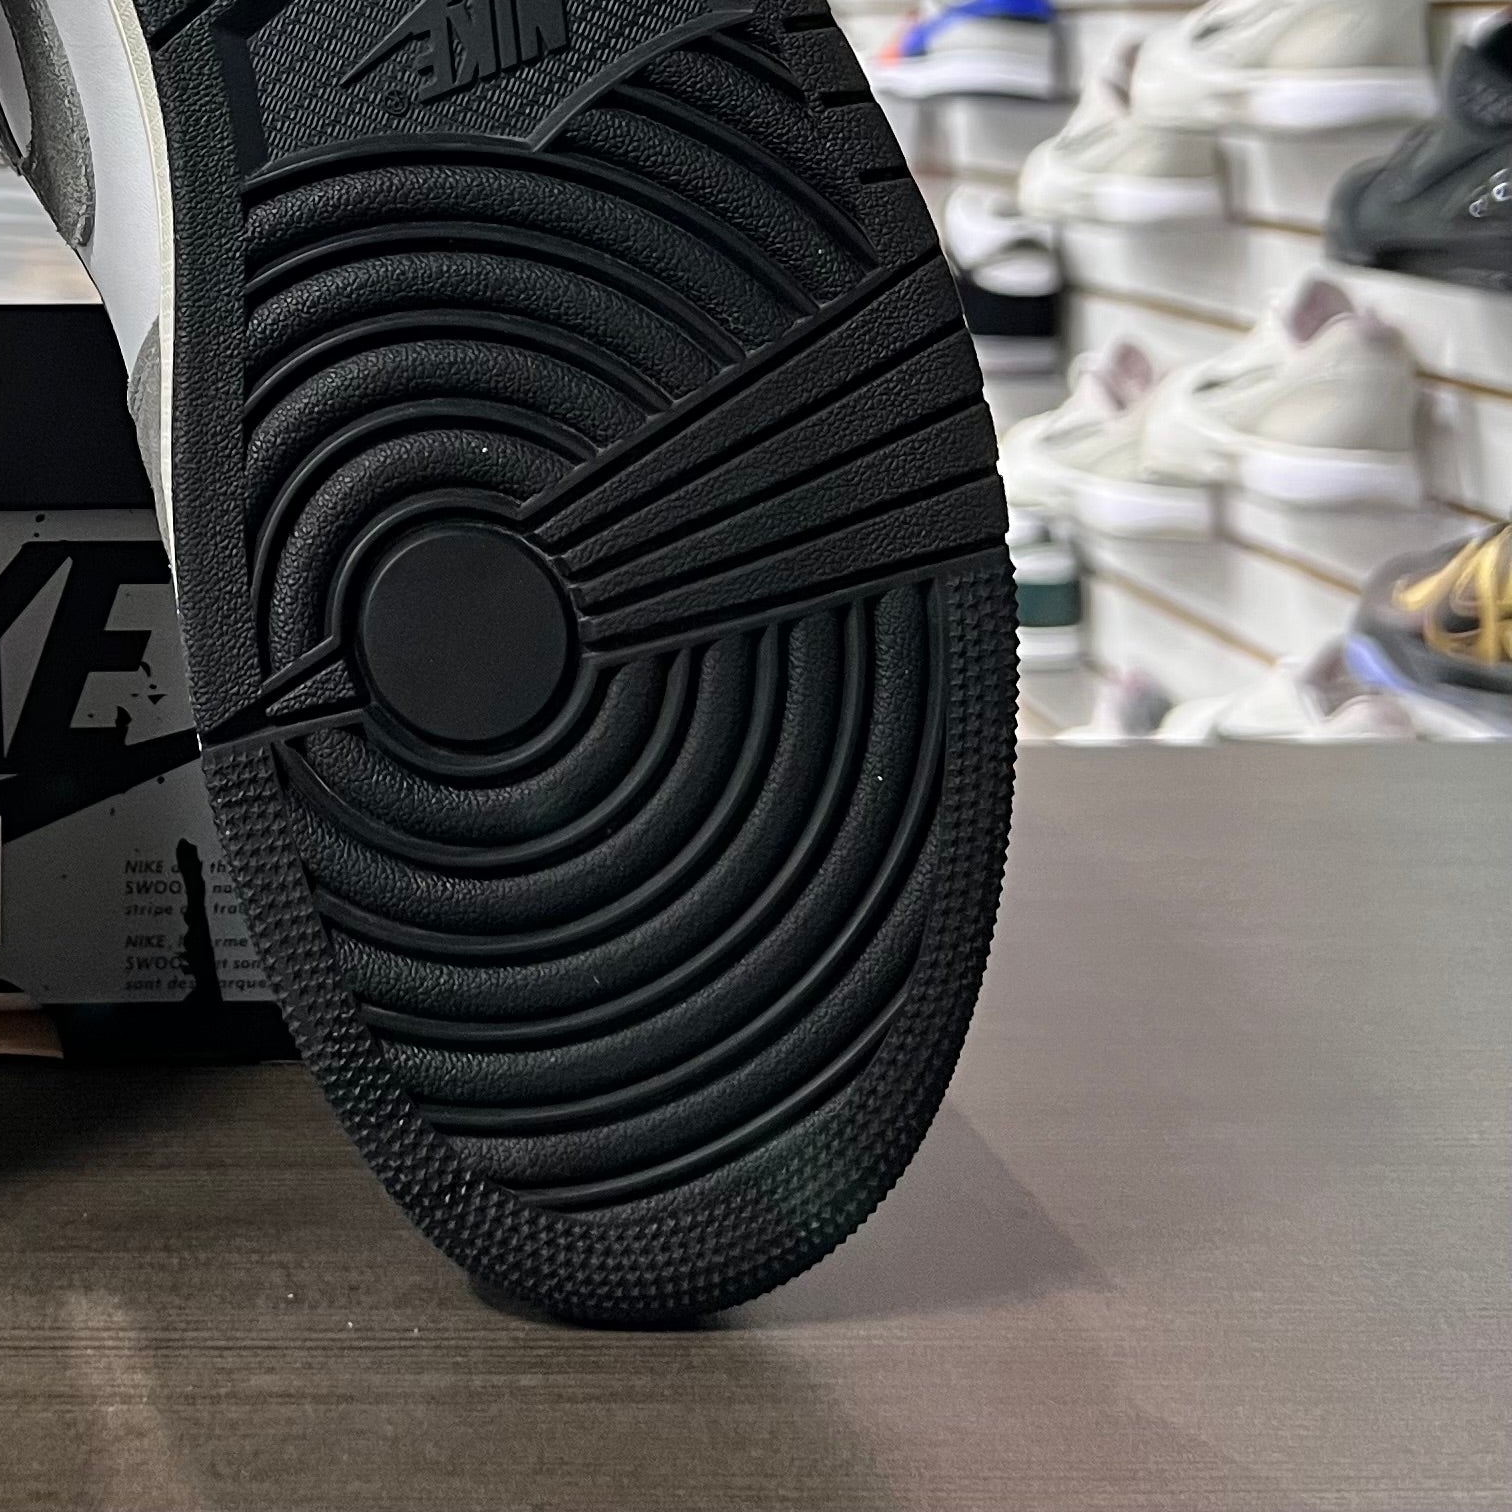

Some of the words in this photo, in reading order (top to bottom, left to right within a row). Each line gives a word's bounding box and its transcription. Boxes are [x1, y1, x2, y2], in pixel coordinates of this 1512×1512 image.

[125, 859, 164, 874] NIKE
[125, 879, 183, 895] SWOO
[124, 903, 174, 918] stripe
